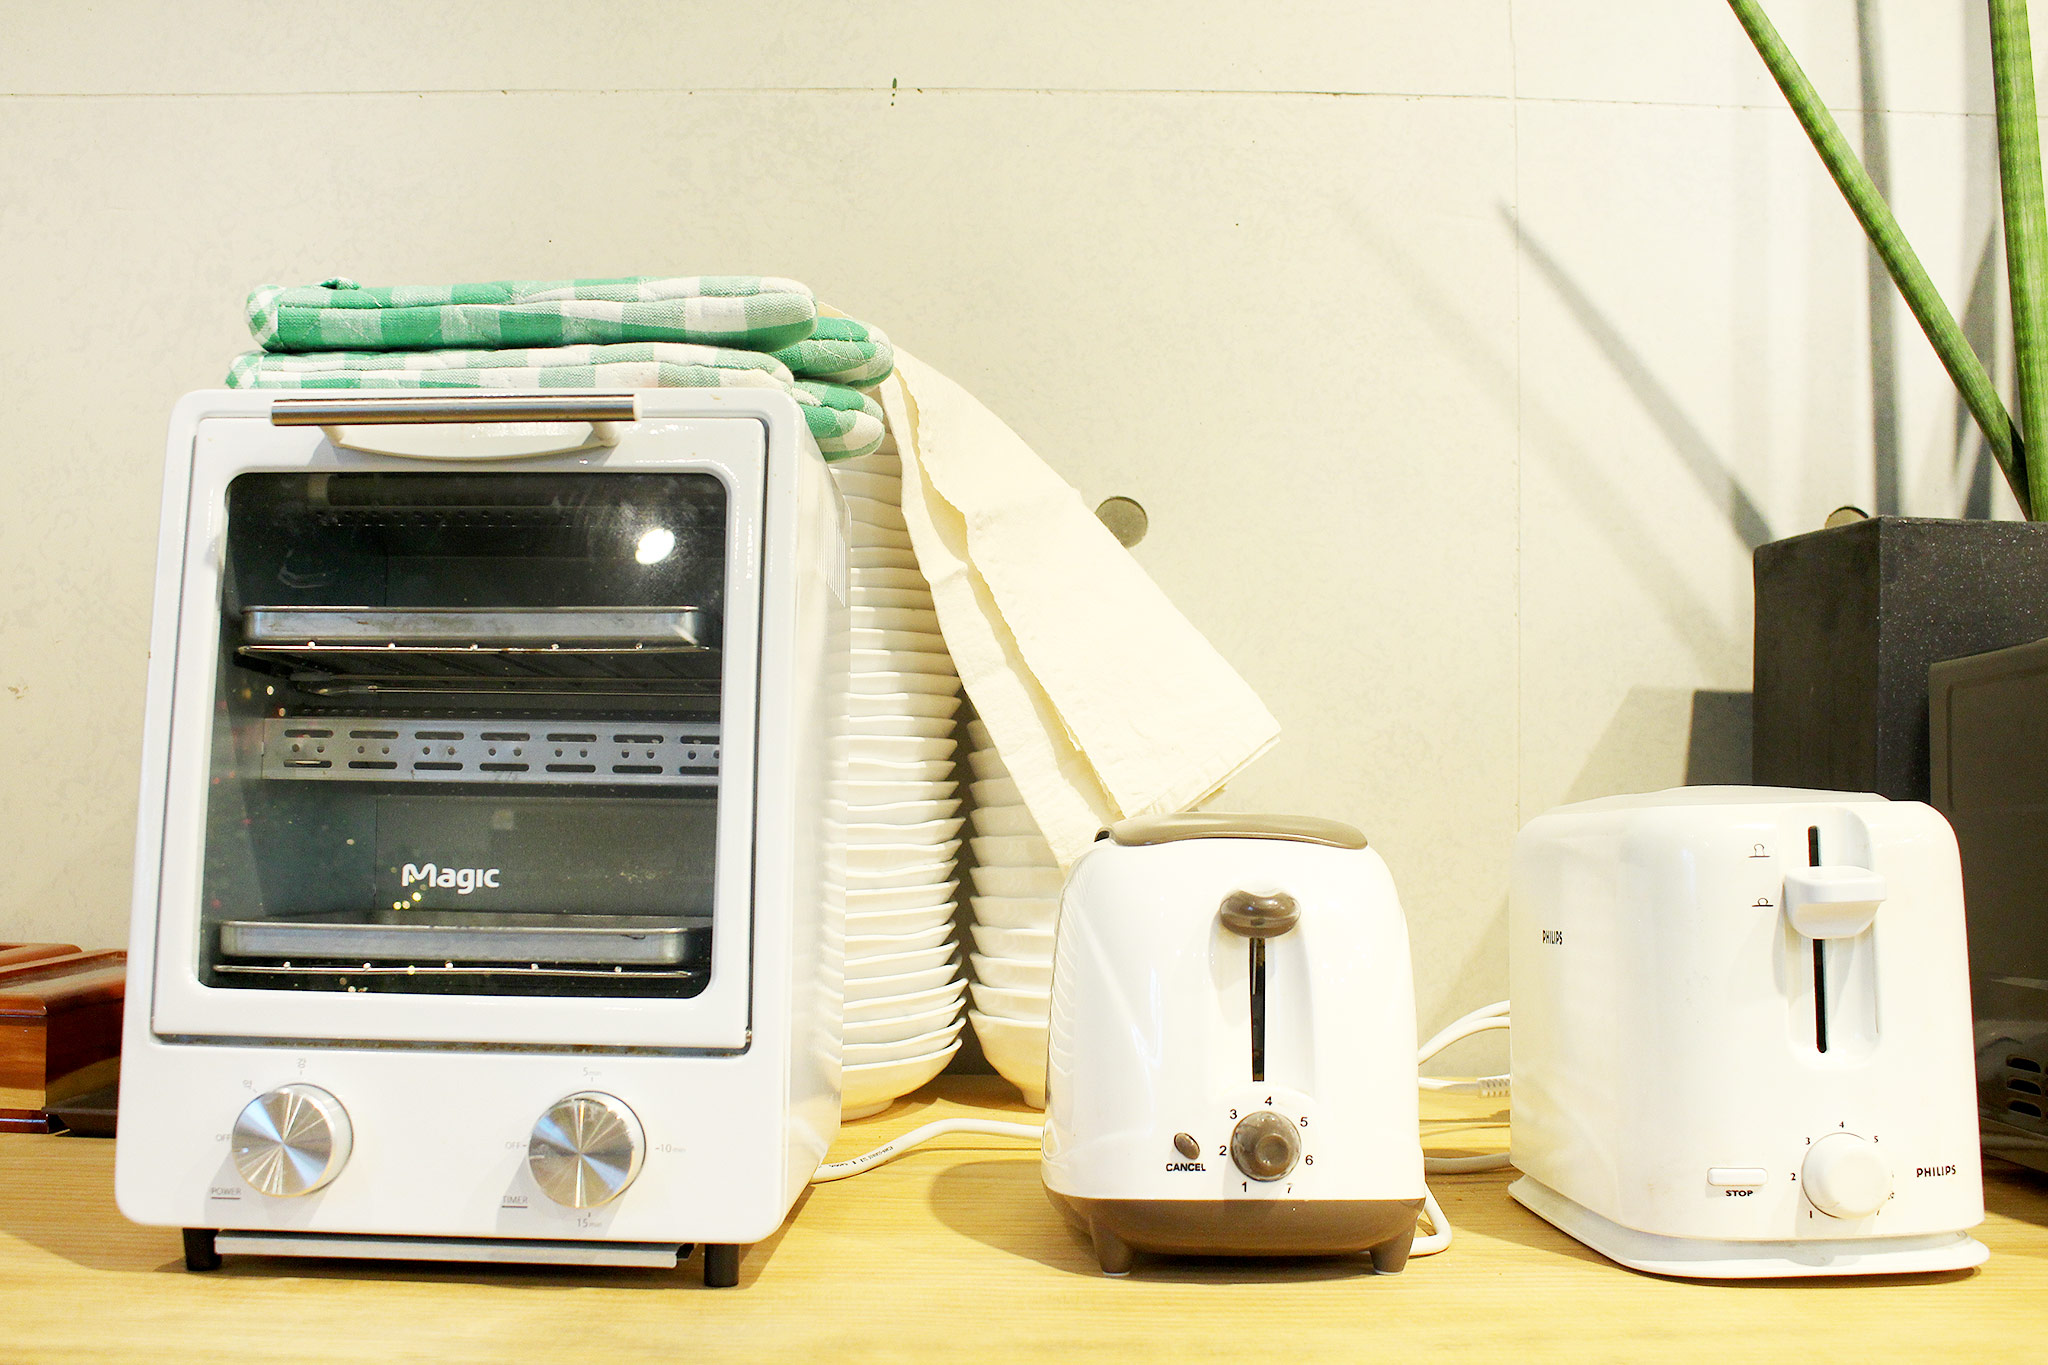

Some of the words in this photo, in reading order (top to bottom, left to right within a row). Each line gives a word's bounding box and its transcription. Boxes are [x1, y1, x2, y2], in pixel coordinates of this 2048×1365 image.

[401, 863, 500, 895] Magic
[1542, 929, 1563, 946] PHILIPS
[1264, 1095, 1273, 1106] 4
[1229, 1108, 1238, 1120] 3
[1300, 1116, 1309, 1127] 5
[1838, 1120, 1845, 1129] 4
[215, 1133, 232, 1142] OFF
[1805, 1137, 1811, 1145] 3
[1873, 1135, 1879, 1144] 5
[1219, 1145, 1227, 1156] 2
[1305, 1154, 1314, 1166] 6
[1165, 1163, 1206, 1172] CANCEL
[1916, 1164, 1957, 1178] PHILIPS
[1790, 1172, 1797, 1182] 2
[210, 1186, 242, 1196] POWER
[1241, 1181, 1248, 1193] 1
[1286, 1182, 1293, 1194] 7
[1725, 1189, 1754, 1197] STOP
[502, 1195, 528, 1205] TIMER
[1808, 1210, 1814, 1219] 1
